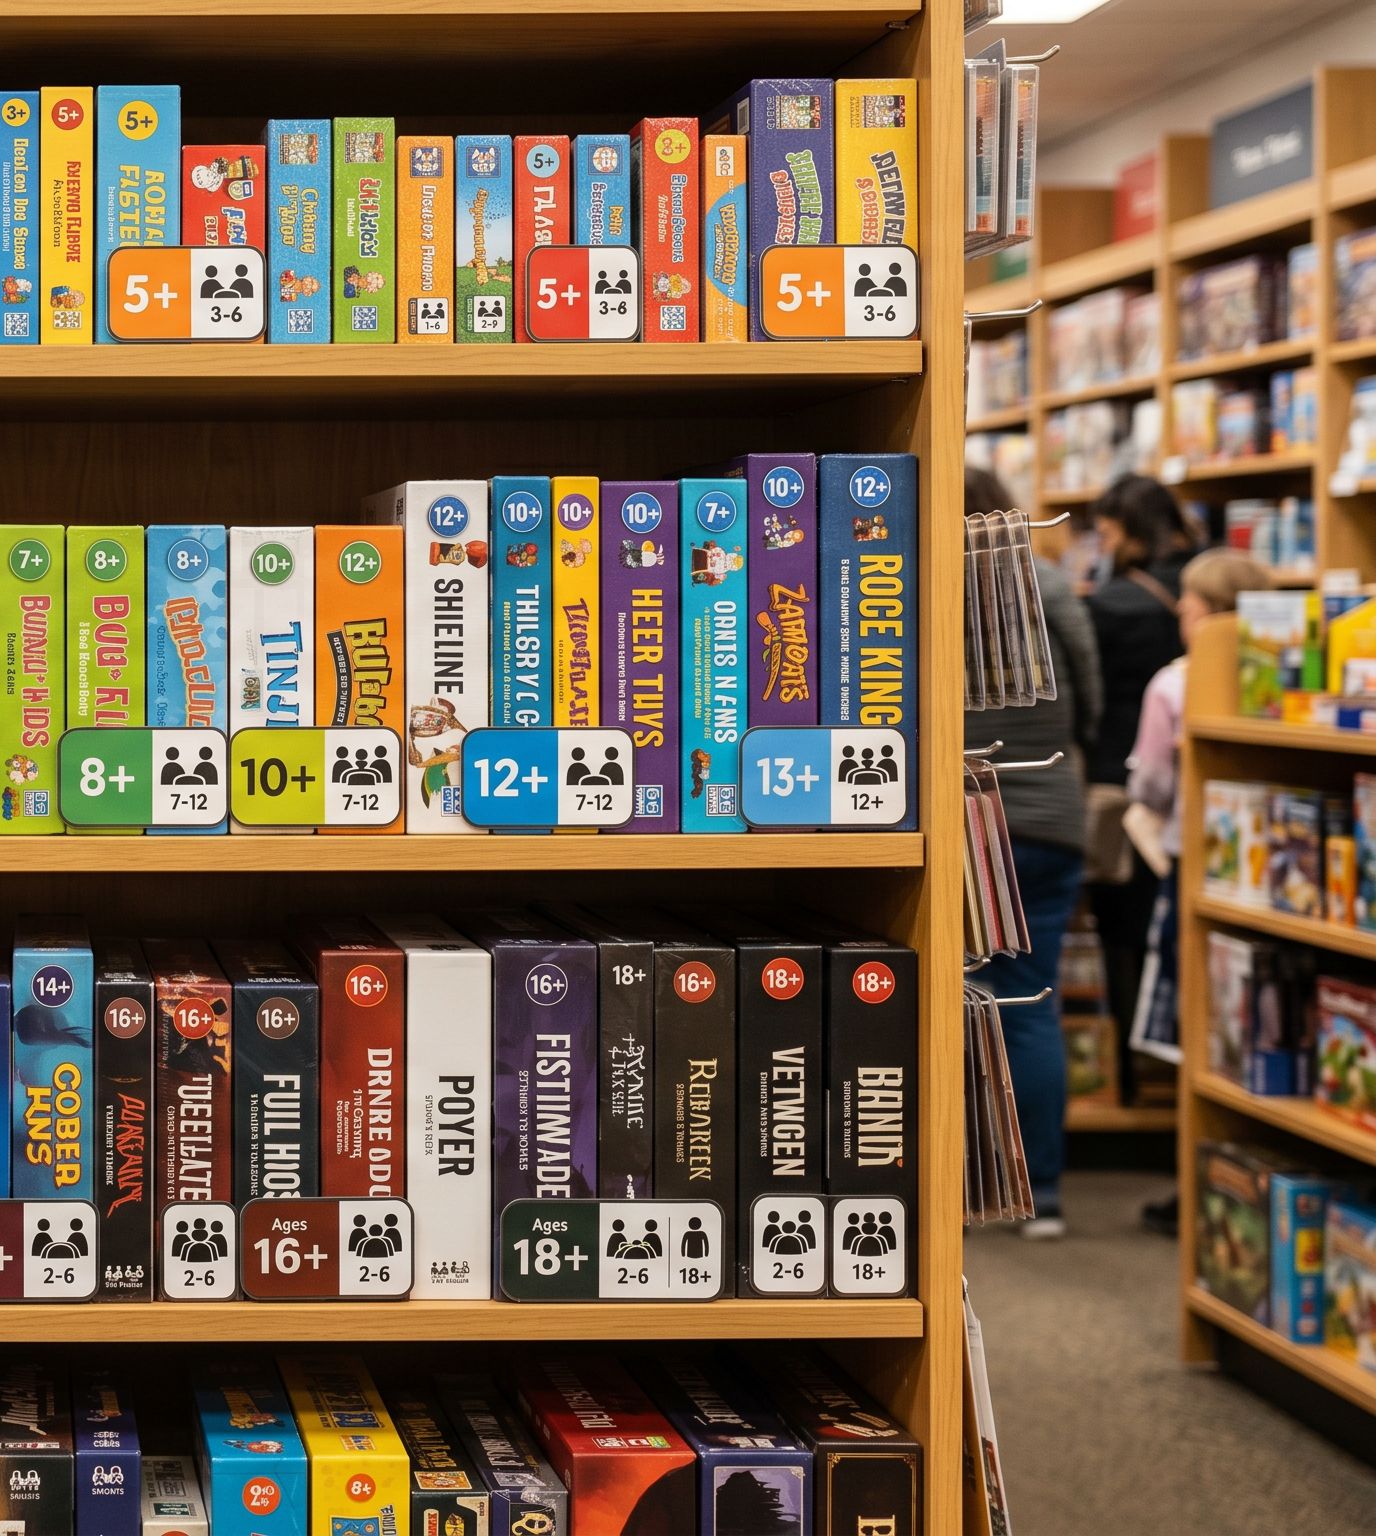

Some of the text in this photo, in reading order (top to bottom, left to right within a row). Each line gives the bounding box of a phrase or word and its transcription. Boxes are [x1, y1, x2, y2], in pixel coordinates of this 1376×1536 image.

[6, 106, 26, 120] 3+
[58, 107, 79, 122] 5+
[125, 111, 153, 130] 5+
[533, 154, 555, 168] 5+
[123, 274, 178, 314] 5+
[537, 279, 581, 308] 5+
[777, 274, 831, 312] 5+
[210, 306, 242, 322] 3-6
[599, 302, 627, 315] 3-6
[864, 305, 896, 321] 3-6
[425, 322, 440, 330] 1-6
[481, 320, 498, 328] 2-9
[768, 478, 801, 497] 10+
[855, 477, 887, 496] 12+
[434, 506, 464, 525] 12+
[508, 503, 539, 521] 10+
[562, 503, 591, 521] 10+
[627, 503, 659, 521] 10+
[706, 503, 729, 521] 7+
[18, 552, 43, 569] 7+
[94, 551, 119, 569] 8+
[177, 552, 202, 570] 8+
[257, 554, 290, 572] 10+
[345, 553, 377, 572] 12+
[632, 589, 663, 663] HEER
[858, 554, 903, 724] ROCE KING
[80, 758, 135, 797] 8+
[241, 757, 316, 797] 10+
[473, 758, 548, 797] 12+
[757, 758, 819, 796] 13+
[171, 794, 207, 810] 7-12
[343, 795, 379, 811] 7-12
[576, 794, 612, 811] 7-12
[851, 793, 883, 809] 12+
[530, 974, 565, 994] 16+
[613, 966, 646, 985] 18+
[679, 973, 711, 992] 16+
[767, 969, 800, 989] 18+
[858, 973, 891, 992] 18+
[37, 977, 70, 995] 14+
[350, 976, 384, 996] 16+
[109, 1009, 143, 1028] 16+
[179, 1009, 212, 1028] 16+
[261, 1009, 296, 1028] 16+
[438, 1075, 475, 1176] POYER
[272, 1218, 307, 1236] Ages
[532, 1219, 568, 1237] Ages
[253, 1238, 328, 1274] 16+
[513, 1239, 589, 1275] 18+
[43, 1268, 74, 1284] 2-6
[184, 1270, 214, 1286] 2-6
[359, 1266, 390, 1282] 2-6
[617, 1268, 649, 1284] 2-6
[679, 1268, 711, 1284] 18+
[773, 1263, 804, 1279] 2-6
[852, 1265, 885, 1280] 18+
